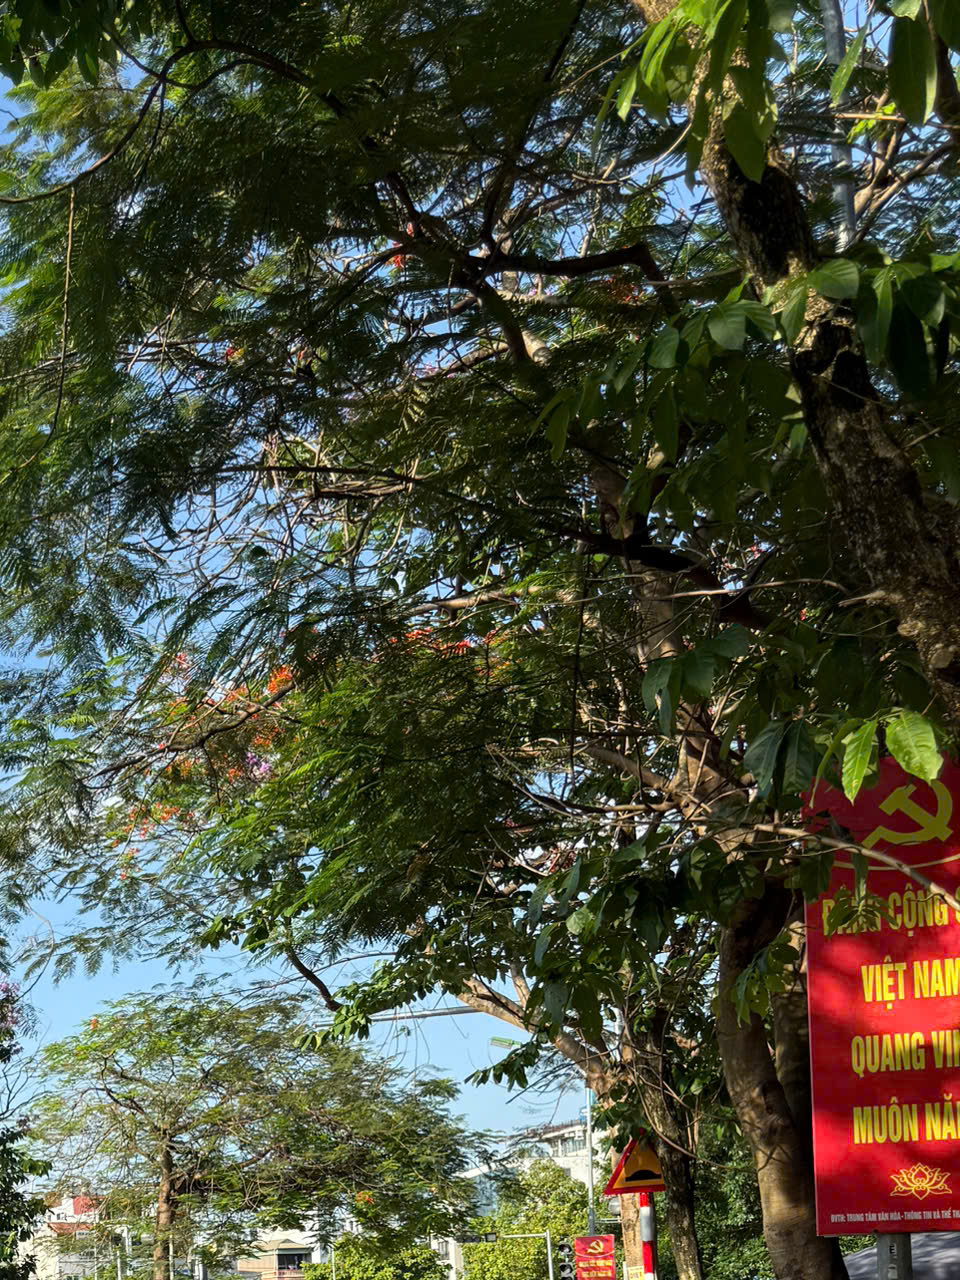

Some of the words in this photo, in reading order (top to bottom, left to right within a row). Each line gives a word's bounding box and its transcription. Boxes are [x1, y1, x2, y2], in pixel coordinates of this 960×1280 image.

[888, 883, 948, 937] CỘNG
[861, 955, 907, 1009] VIỆT
[913, 958, 960, 999] NAM
[851, 1031, 925, 1078] QUANG
[853, 1096, 919, 1144] MUÔN
[924, 1092, 960, 1141] NĂ
